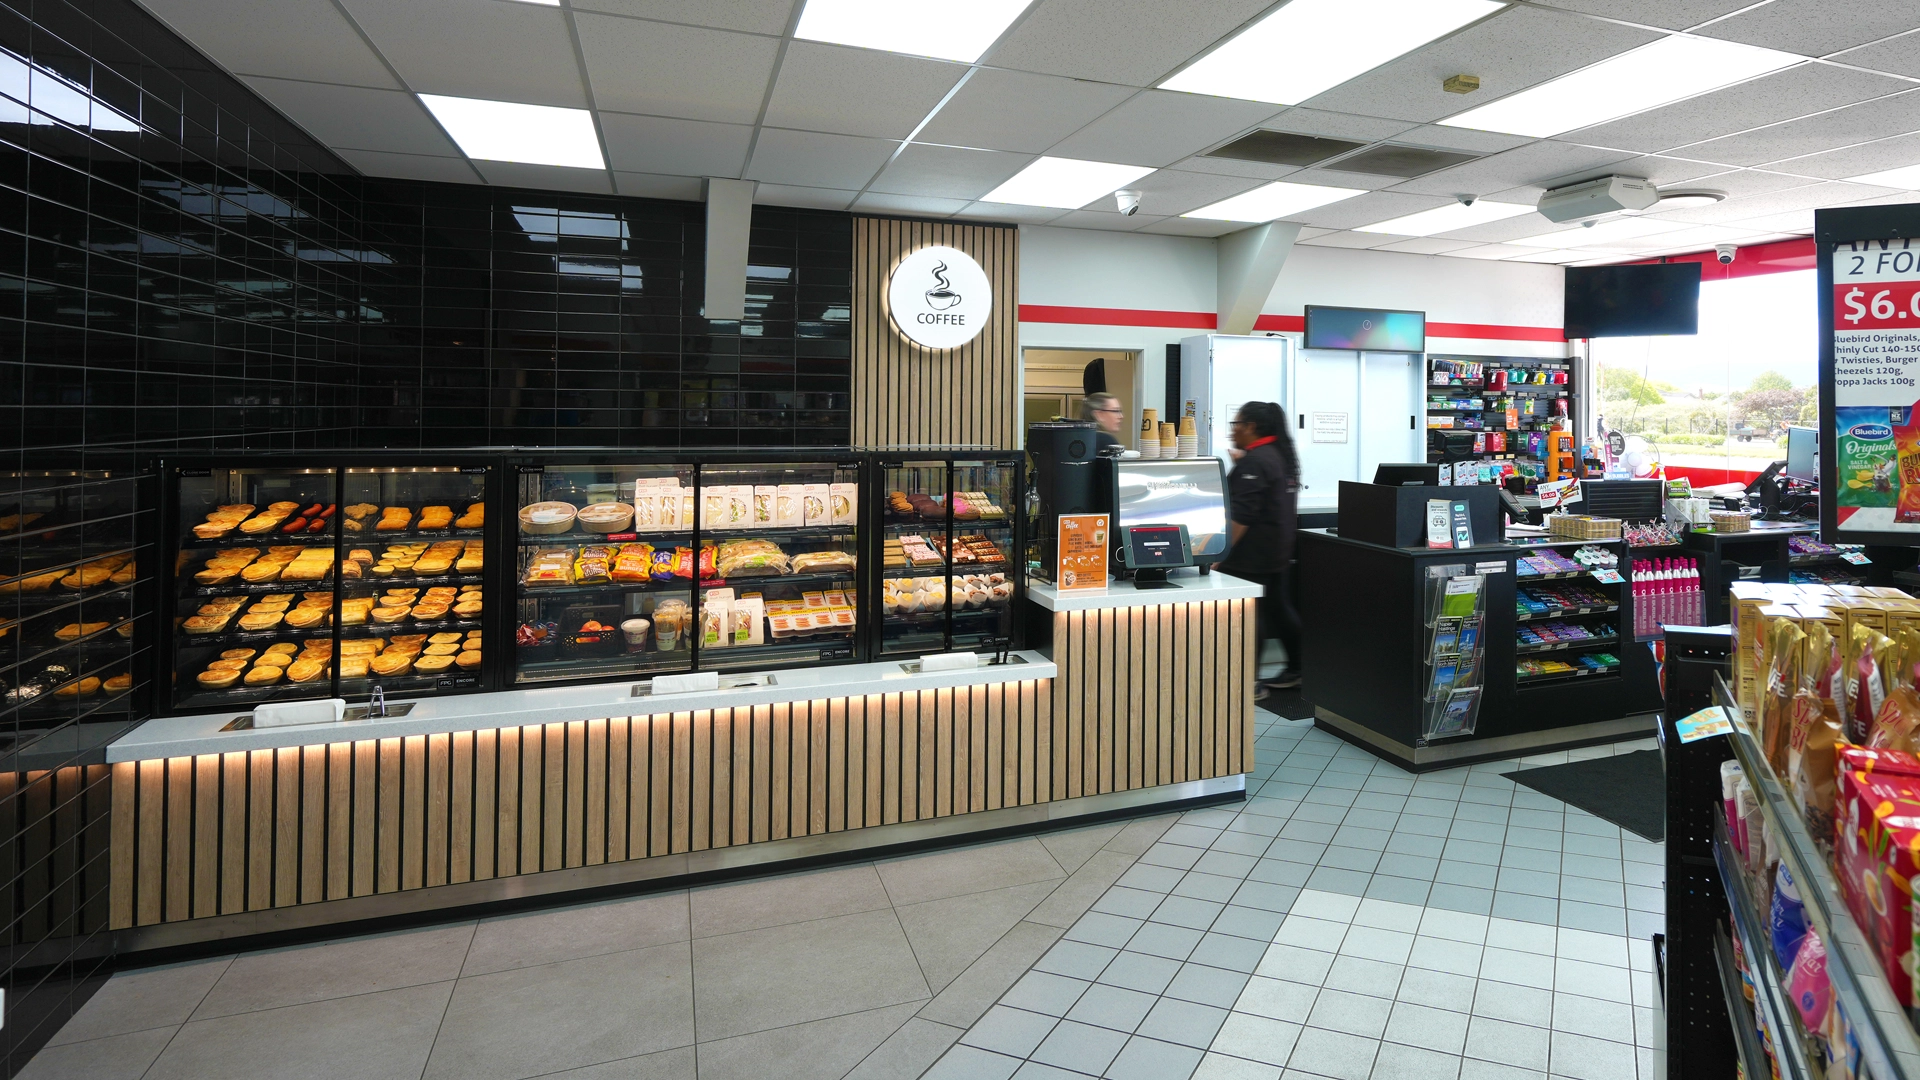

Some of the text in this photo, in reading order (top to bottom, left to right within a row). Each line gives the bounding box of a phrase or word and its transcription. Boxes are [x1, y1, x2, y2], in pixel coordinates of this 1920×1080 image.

[1848, 256, 1865, 275] 2
[917, 312, 965, 326] COFFEE
[1873, 334, 1920, 344] Originals,
[1835, 346, 1860, 355] hinly
[1862, 345, 1879, 353] Cut
[1841, 356, 1883, 364] Twisties,
[1885, 356, 1918, 365] Burger
[1876, 367, 1904, 376] 120g,
[1890, 377, 1915, 387] 100g
[1845, 440, 1897, 459] Originals
